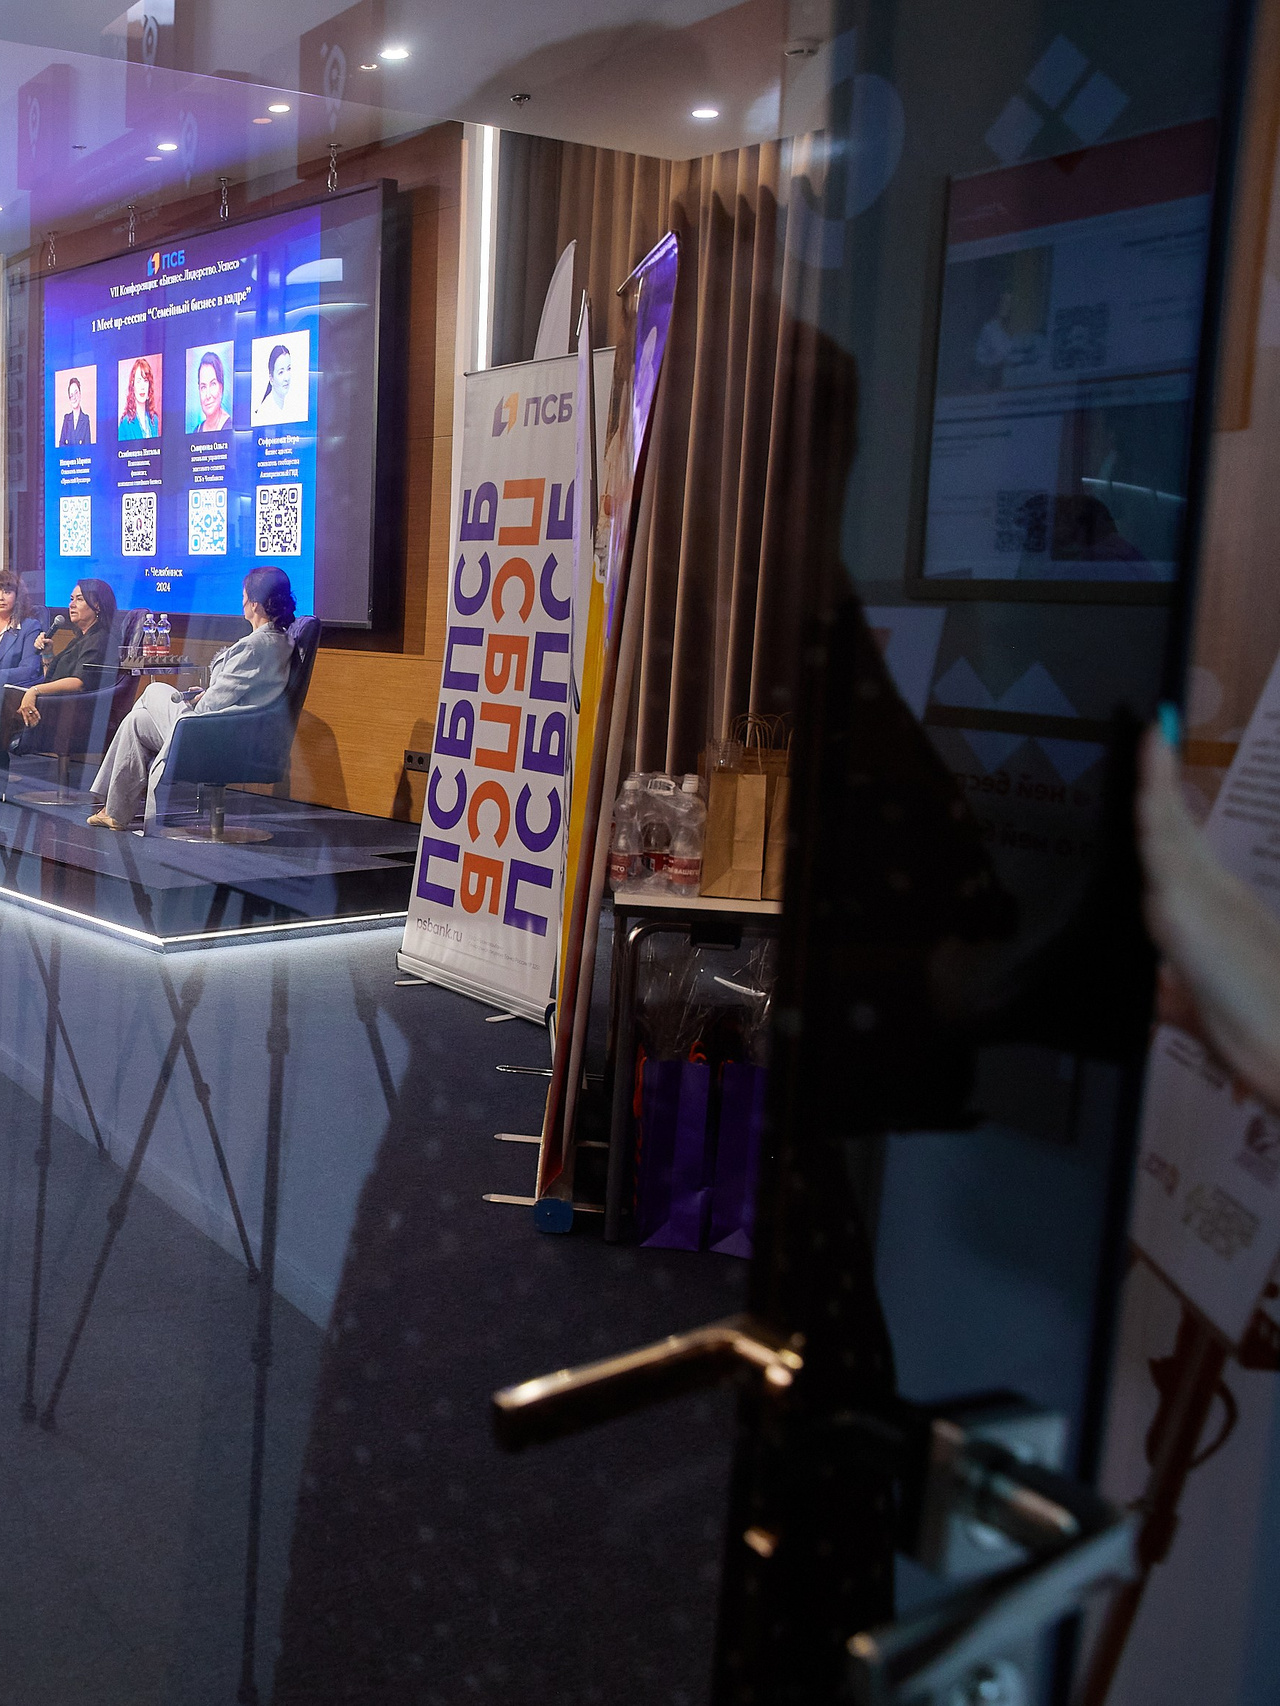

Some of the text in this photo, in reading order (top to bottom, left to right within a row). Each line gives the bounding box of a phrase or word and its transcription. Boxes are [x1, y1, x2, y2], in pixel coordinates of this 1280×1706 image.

[162, 250, 185, 270] ПСБ
[97, 318, 113, 332] Meet
[191, 298, 217, 313] бизнес
[218, 296, 223, 306] в
[523, 391, 574, 428] ПСБ
[150, 566, 183, 577] Челябинск
[156, 581, 171, 592] 2024
[416, 917, 463, 943] psbank.ru
